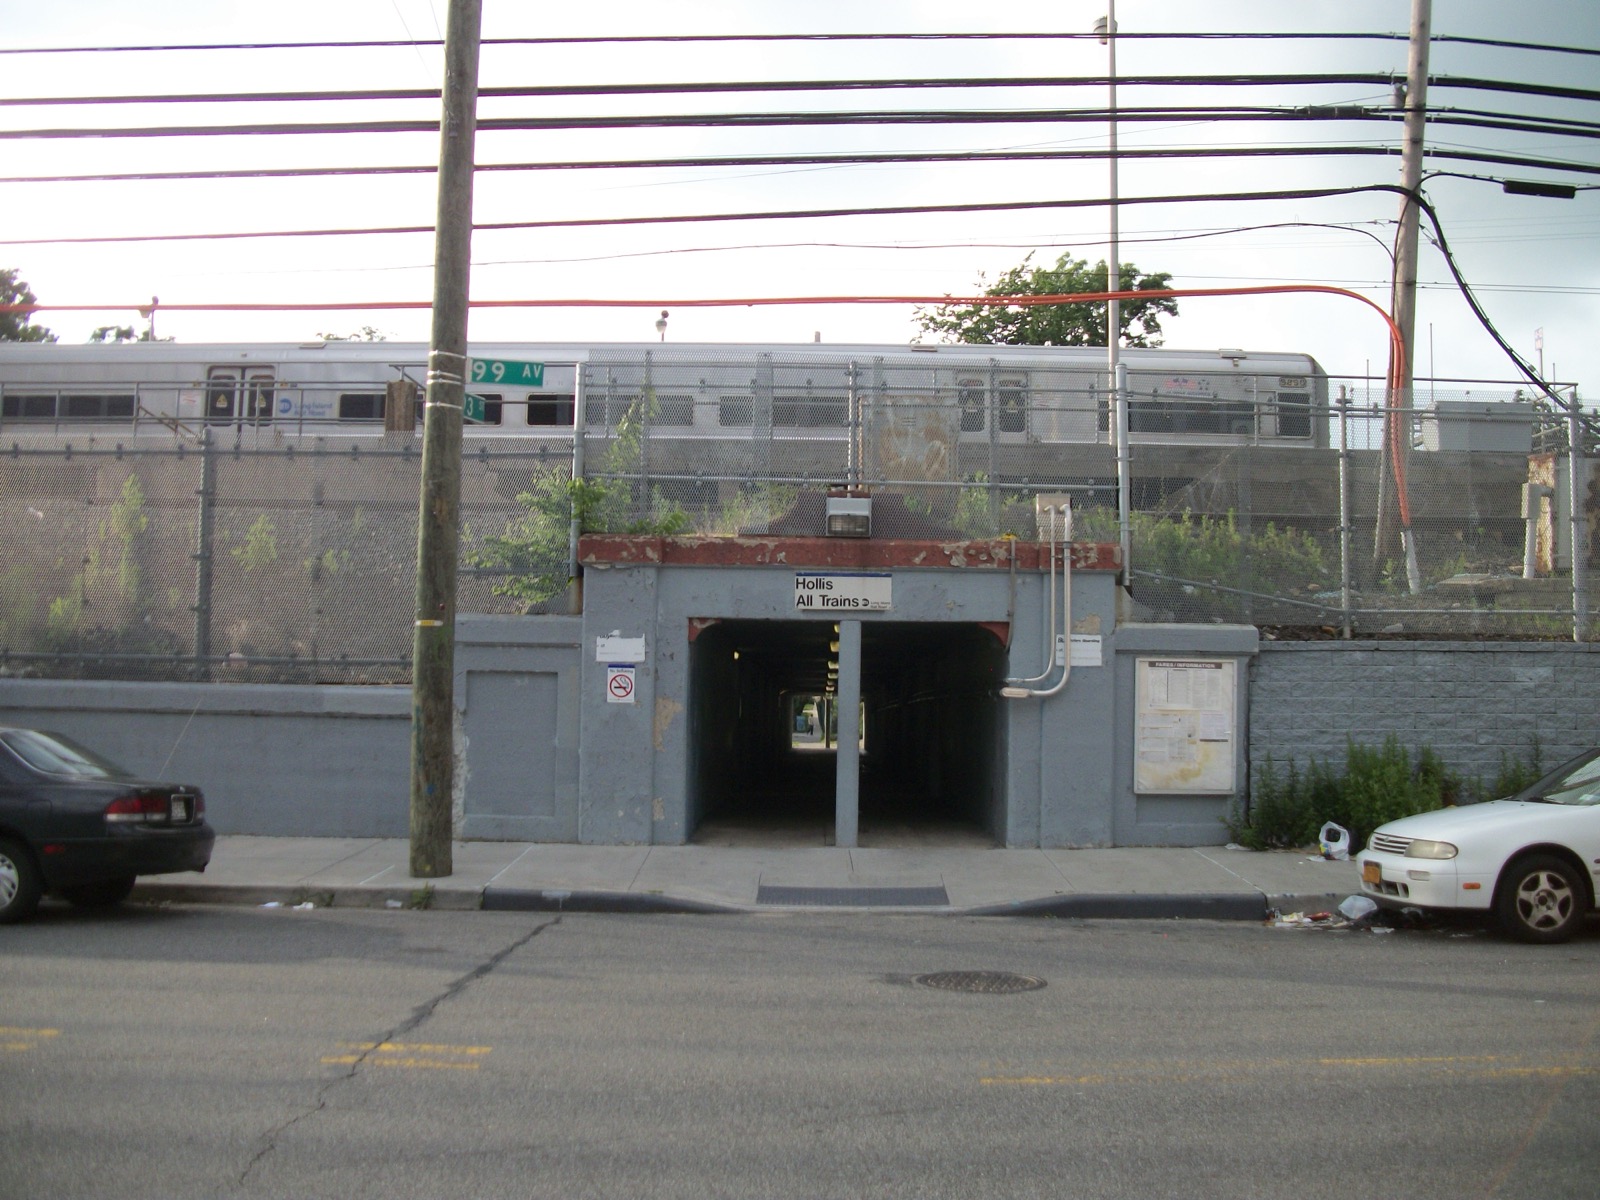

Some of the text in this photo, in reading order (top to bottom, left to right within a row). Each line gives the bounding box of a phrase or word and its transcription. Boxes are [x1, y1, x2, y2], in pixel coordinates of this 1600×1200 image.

[473, 360, 542, 382] 99 AV
[464, 396, 473, 416] 3
[796, 577, 833, 590] Hollis
[796, 594, 812, 606] All
[819, 594, 859, 607] Trains
